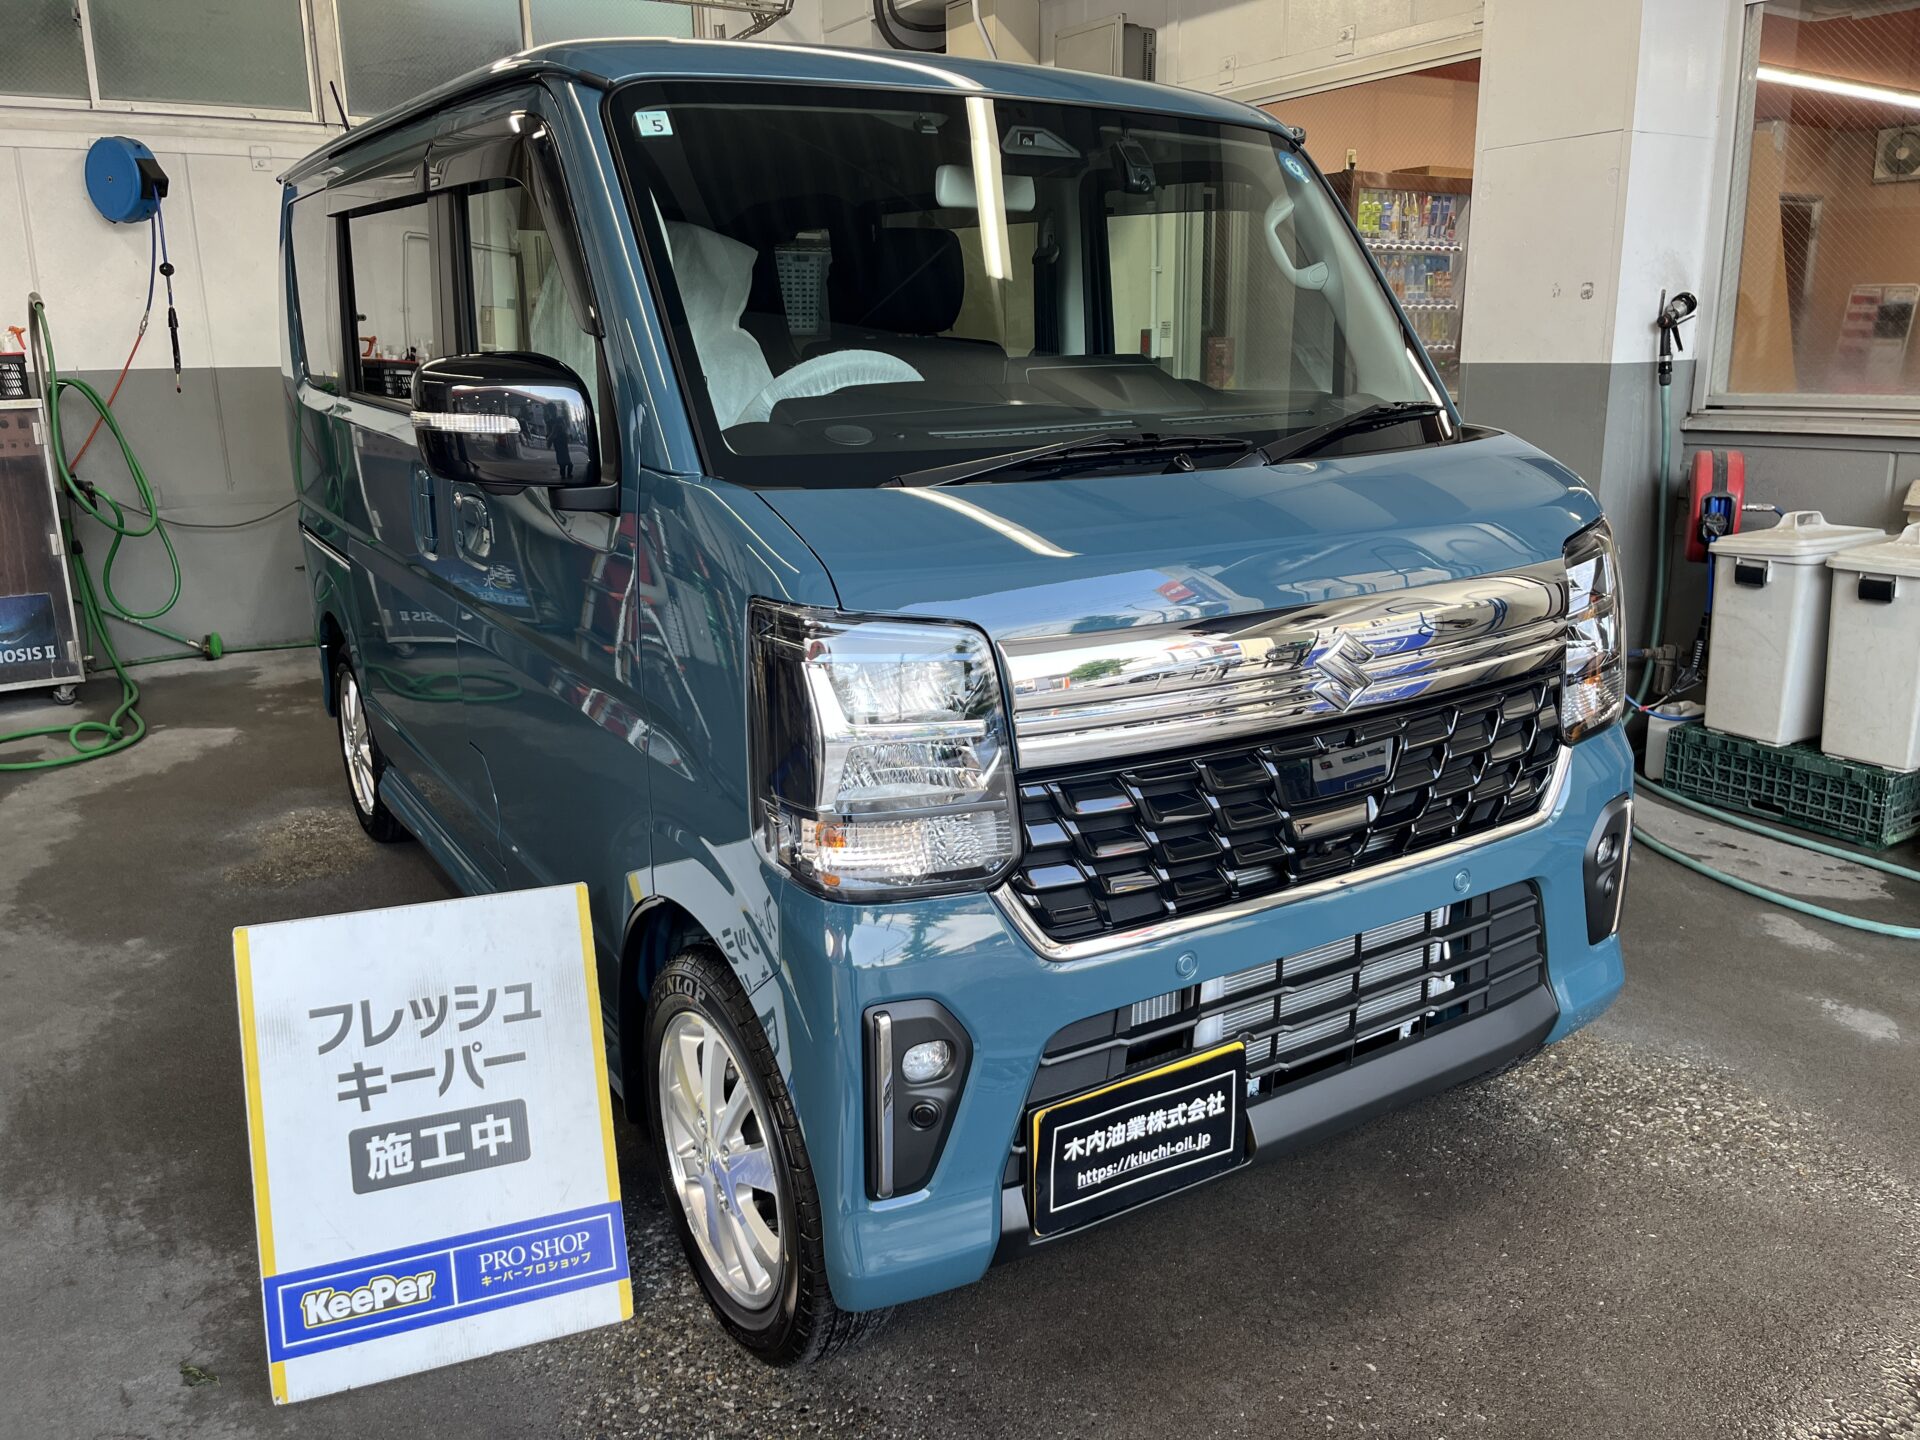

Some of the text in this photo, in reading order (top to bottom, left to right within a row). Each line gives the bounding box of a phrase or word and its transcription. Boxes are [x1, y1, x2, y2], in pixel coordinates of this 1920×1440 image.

[651, 119, 664, 132] 5
[308, 982, 542, 1055] フレッシュ
[337, 1041, 527, 1112] キーパー
[366, 1113, 513, 1180] 施工中
[1063, 1090, 1226, 1162] 木内油業株式会社
[1077, 1132, 1211, 1190] https://kiuchi-oil.jp
[479, 1231, 590, 1273] PRO SHOP
[481, 1251, 591, 1287] キーパープロショップ
[302, 1271, 435, 1328] KeePer
